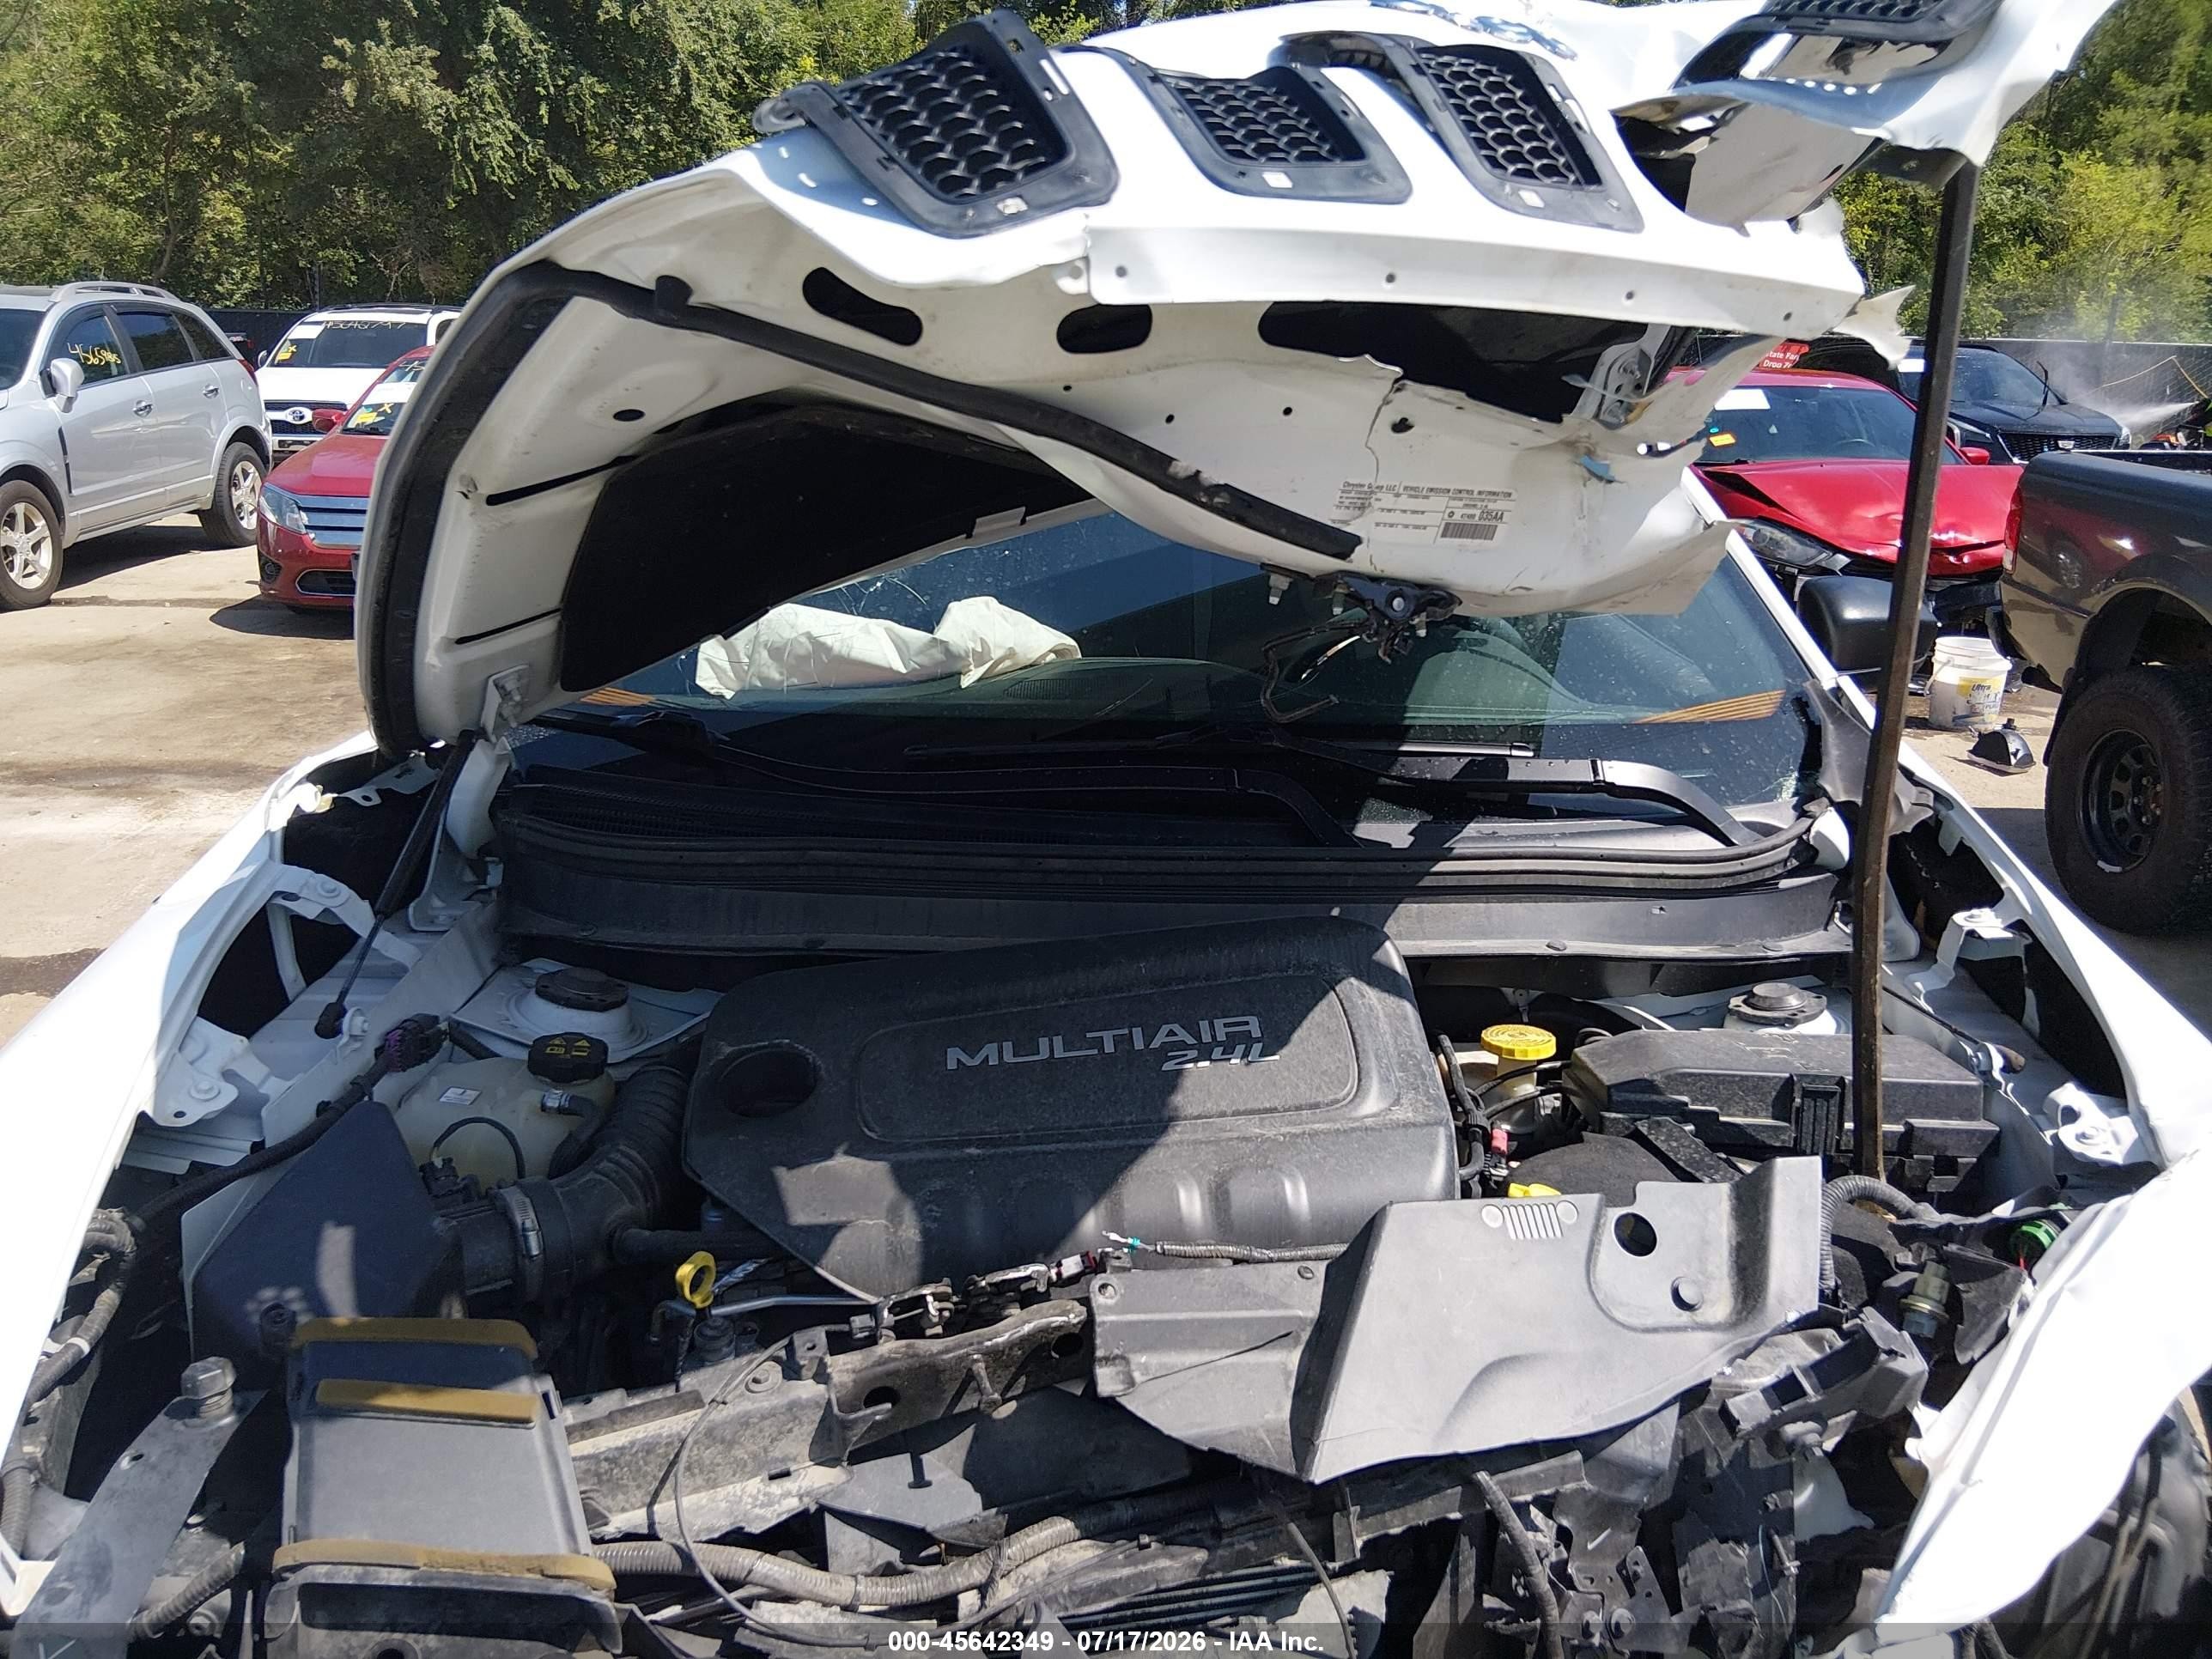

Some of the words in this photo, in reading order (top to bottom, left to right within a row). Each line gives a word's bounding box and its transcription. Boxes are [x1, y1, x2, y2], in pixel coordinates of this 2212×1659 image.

[1785, 352, 1800, 361] Far
[1342, 481, 1366, 490] Chrysler
[1451, 488, 1475, 496] CONTROL
[1476, 489, 1512, 498] INFORMATION
[945, 1015, 1262, 1071] MULTIAIR
[1160, 1042, 1281, 1072] 2.4L
